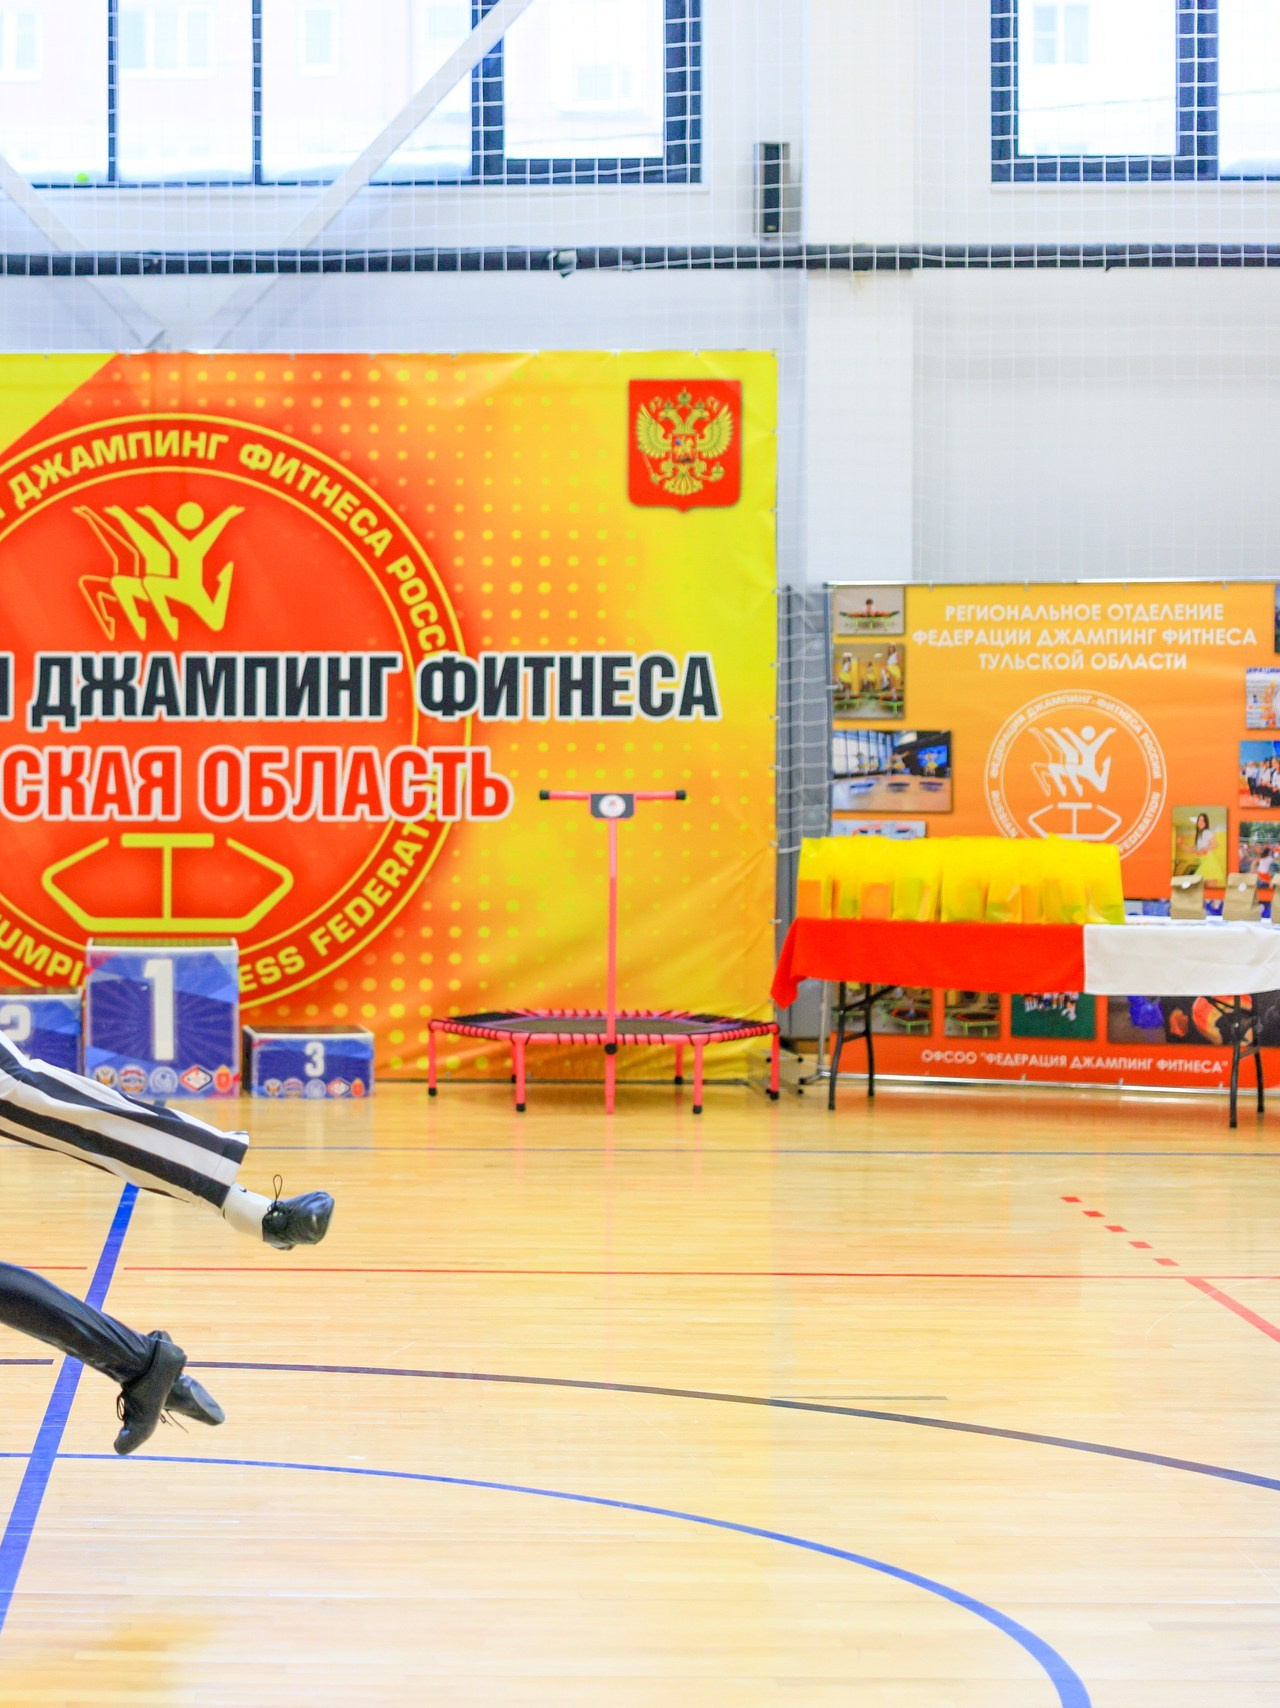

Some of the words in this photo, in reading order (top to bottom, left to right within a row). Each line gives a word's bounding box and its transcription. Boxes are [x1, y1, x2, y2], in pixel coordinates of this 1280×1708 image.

[8, 430, 229, 510] ДЖАМПИНГ
[239, 443, 393, 557] ФИТНЕСА
[386, 555, 449, 659] РОСС
[912, 628, 1031, 648] ФЕДЕРАЦИИ
[1037, 628, 1155, 648] ДЖАМПИНГ
[1161, 628, 1257, 646] ФИТНЕСА
[945, 603, 1101, 622] РЕГИОНАЛЬНОЕ
[1107, 603, 1224, 623] ОТДЕЛЕНИЕ
[978, 650, 1084, 671] ТУЛЬСКОЙ
[1091, 651, 1187, 671] ОБЛАСТИ
[29, 654, 399, 730] ДЖАМПИНГ
[418, 654, 719, 718] ФИТНЕСА
[202, 749, 513, 819] ОБЛАСТЬ
[309, 812, 436, 957] FEDERAT
[143, 958, 175, 1062] 1
[304, 1042, 325, 1078] 3
[921, 1050, 977, 1064] ОФСОО
[980, 1052, 1068, 1068] "ФЕДЕРАЦИЯ
[1071, 1055, 1152, 1070] ДЖАМПИНГ
[1156, 1058, 1229, 1074] ФИТНЕСА"
